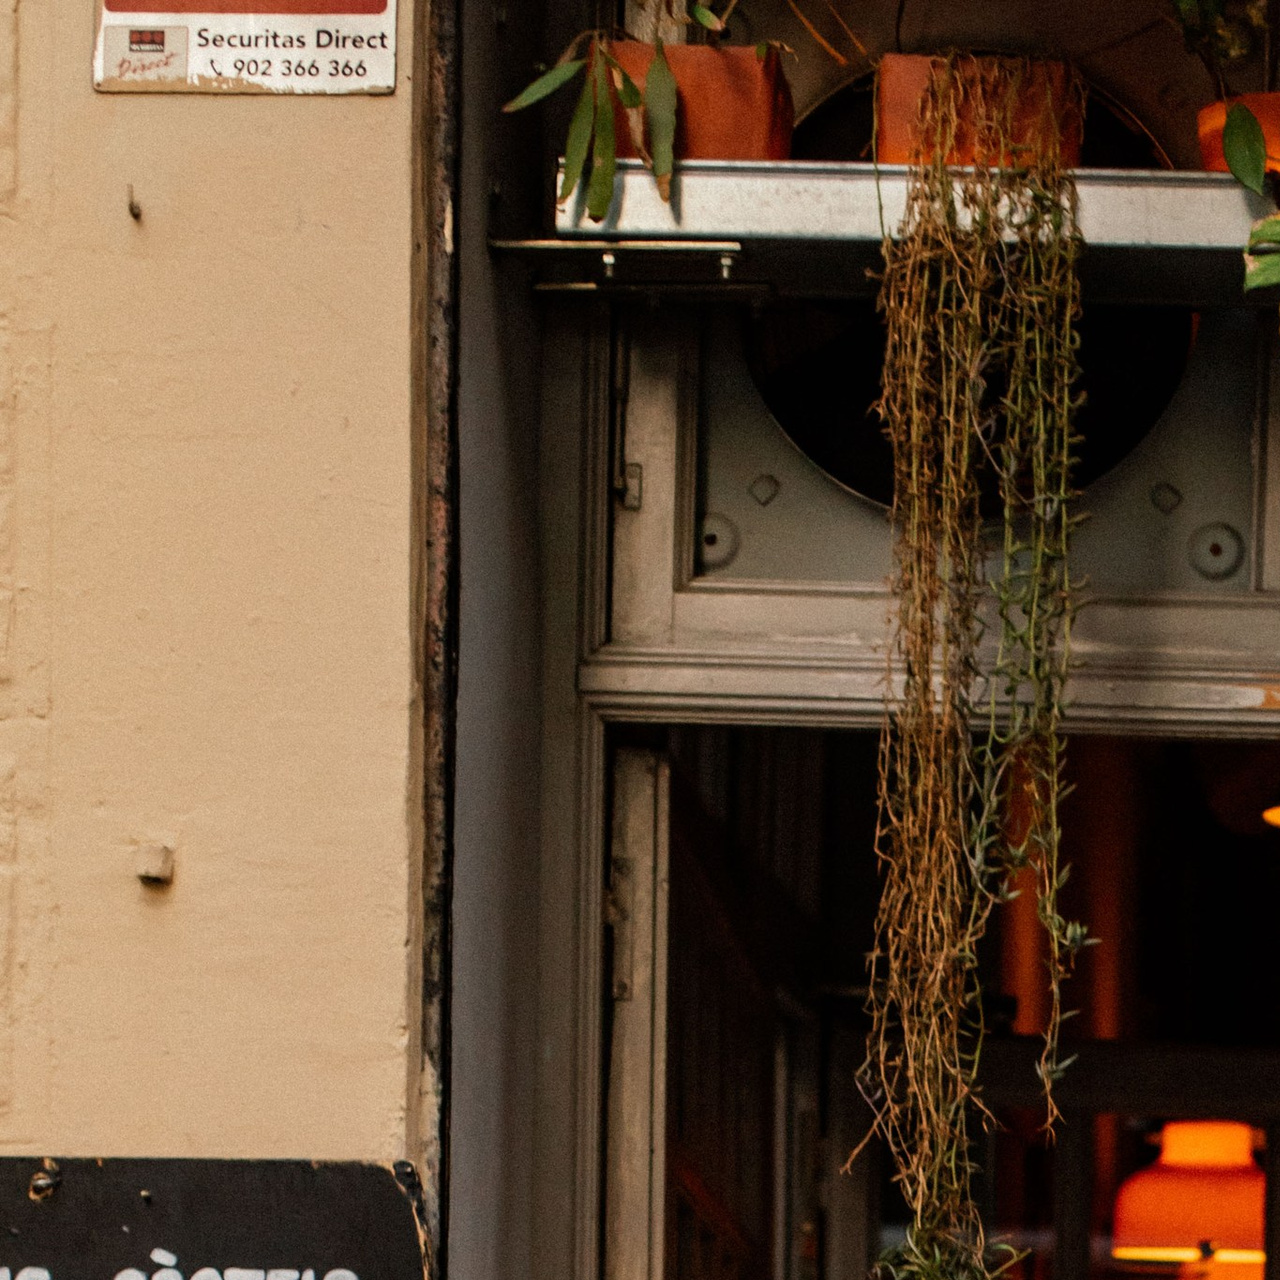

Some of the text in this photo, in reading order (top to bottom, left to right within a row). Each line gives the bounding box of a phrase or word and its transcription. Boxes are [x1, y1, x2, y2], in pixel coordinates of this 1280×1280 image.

[197, 28, 389, 49] Securitas Direct
[233, 59, 367, 77] 902 366 366
